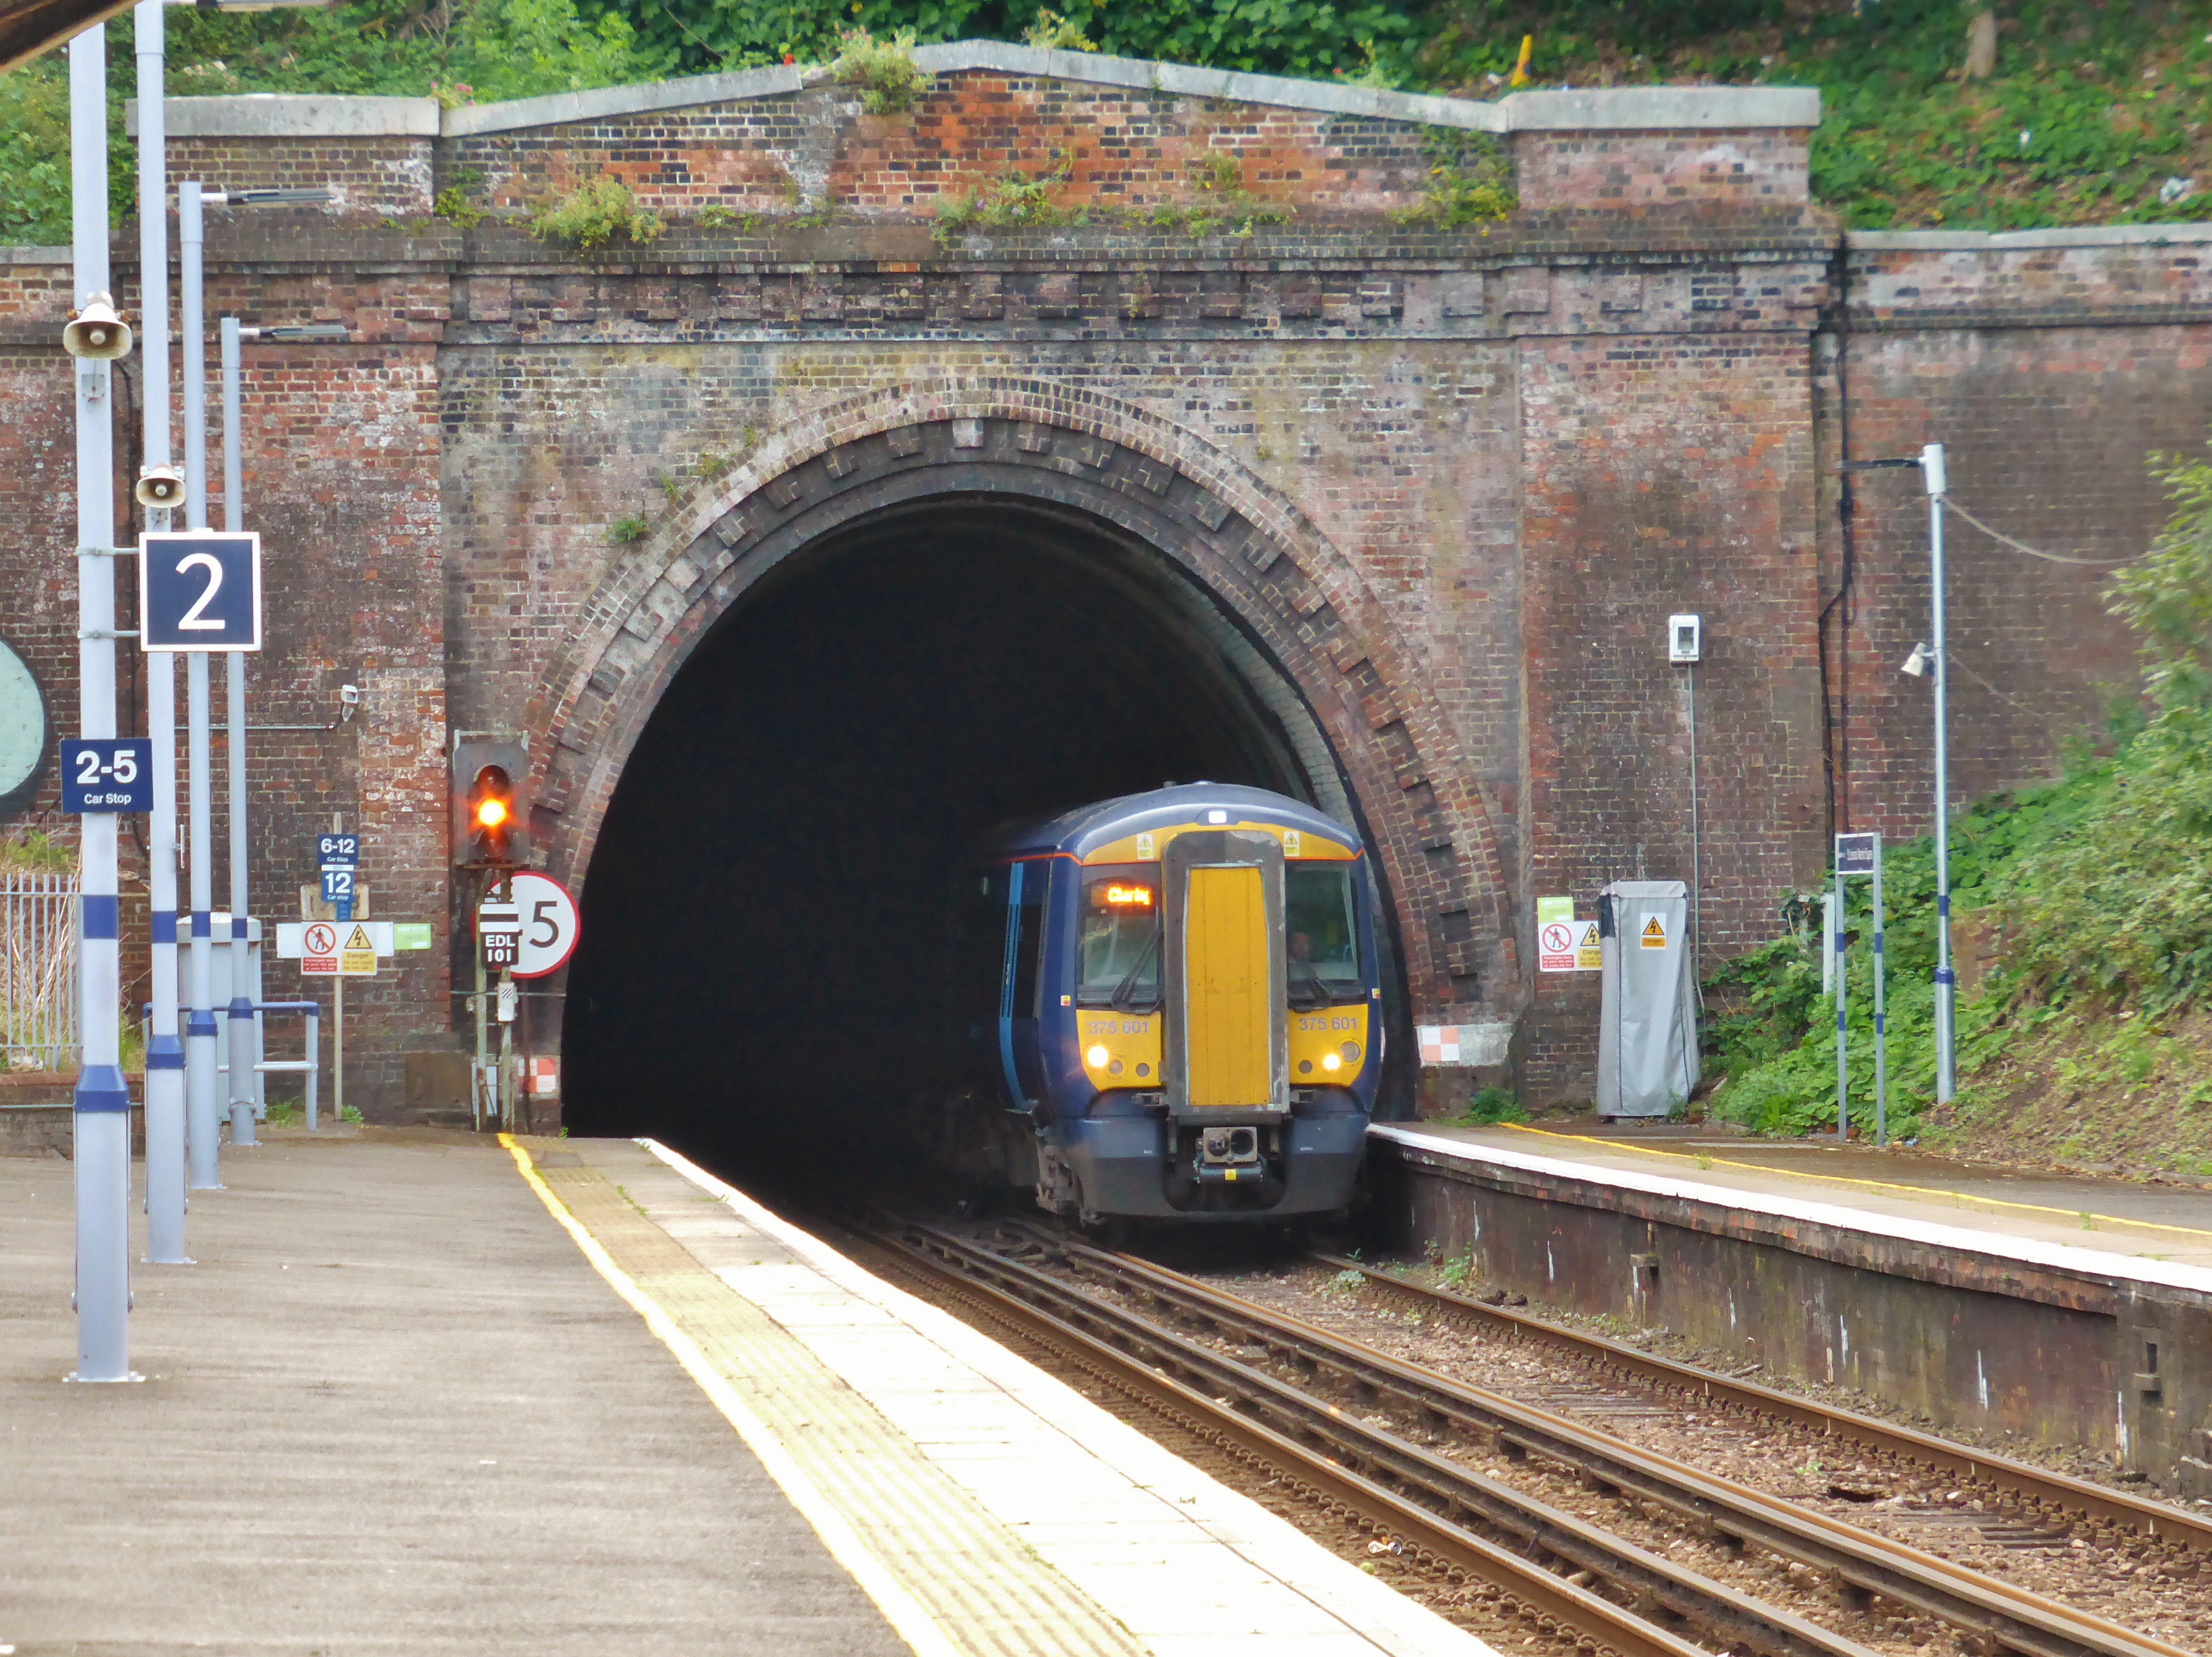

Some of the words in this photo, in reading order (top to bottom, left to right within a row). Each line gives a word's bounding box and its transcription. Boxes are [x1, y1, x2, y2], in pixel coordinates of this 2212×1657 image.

[176, 553, 225, 630] 2
[76, 750, 137, 784] 2-5
[84, 794, 103, 804] Car
[106, 793, 131, 805] Stop
[321, 838, 355, 853] 6-12
[325, 872, 351, 893] 12
[485, 935, 516, 947] EDL
[488, 949, 511, 962] 101
[1089, 1020, 1117, 1035] 375
[1123, 1020, 1149, 1034] 601
[1299, 1017, 1327, 1031] 375
[1332, 1017, 1357, 1030] 601
